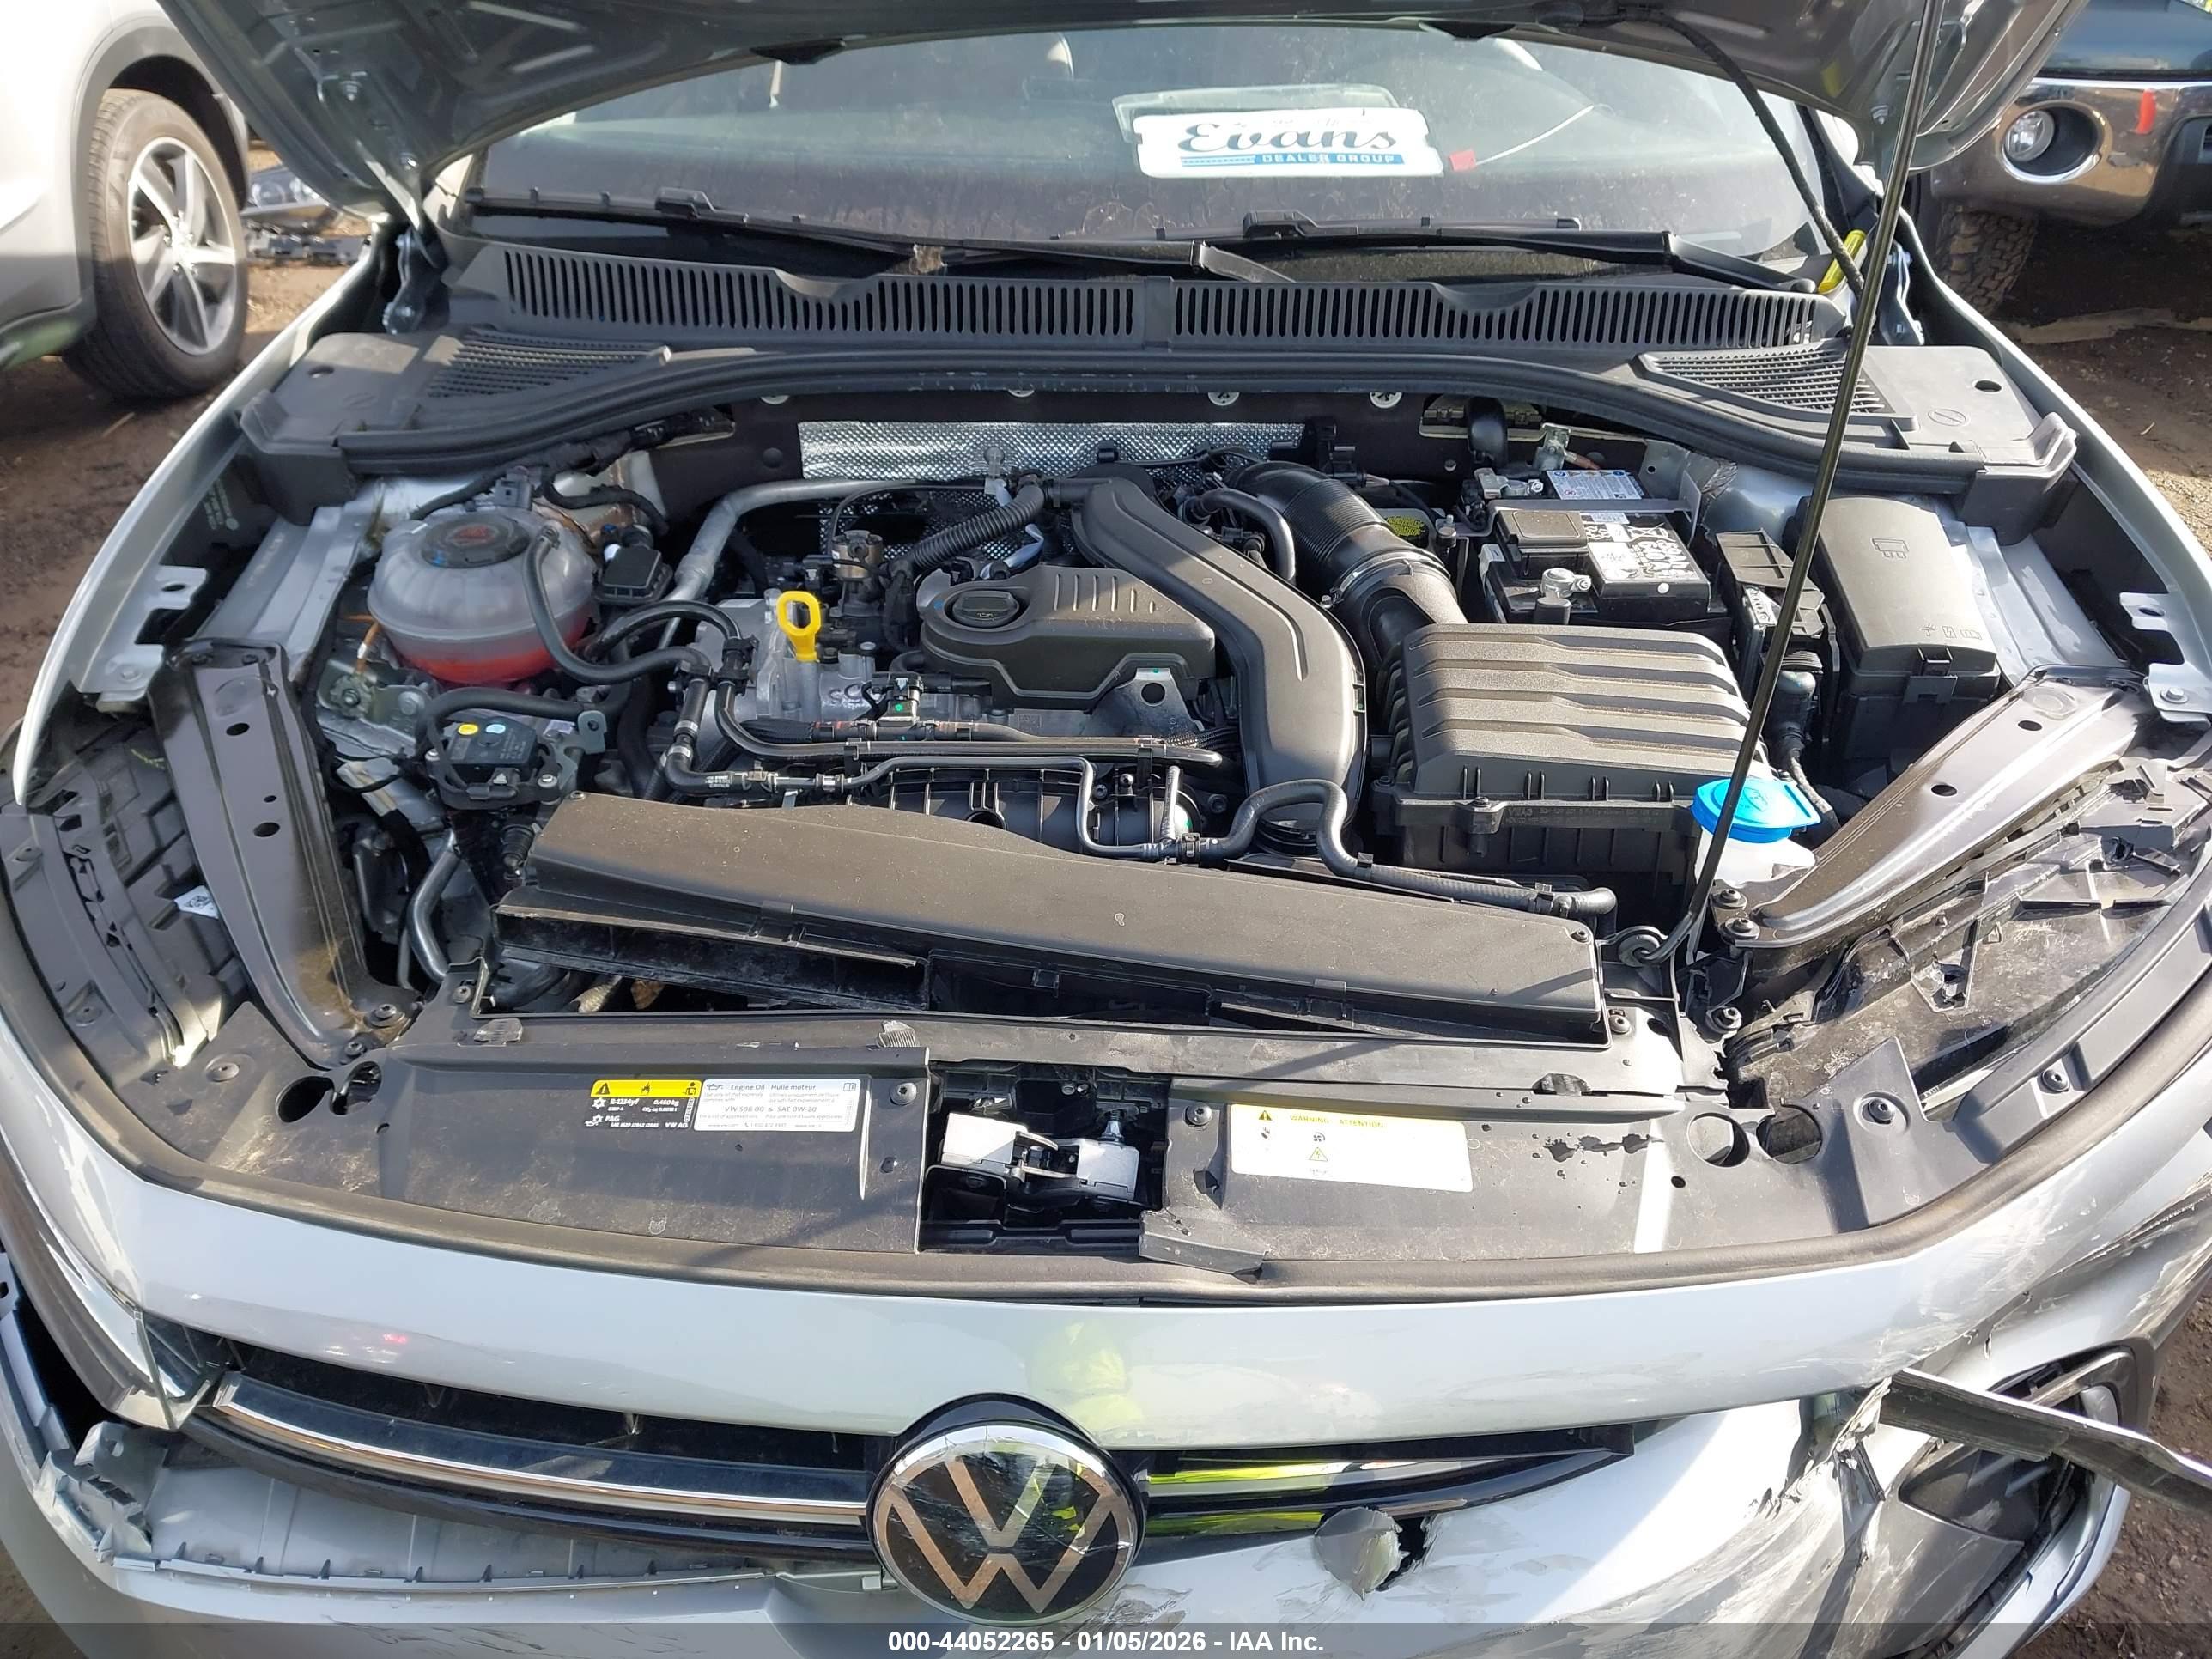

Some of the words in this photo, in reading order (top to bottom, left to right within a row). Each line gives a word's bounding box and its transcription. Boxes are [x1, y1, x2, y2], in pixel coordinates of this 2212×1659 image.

[1178, 123, 1396, 153] Evans
[1263, 154, 1329, 164] DEALER
[1336, 153, 1395, 163] GROUP
[1290, 1115, 1329, 1124] WARNING
[1339, 1119, 1384, 1127] ATTENTION
[884, 1444, 1121, 1614] VW
